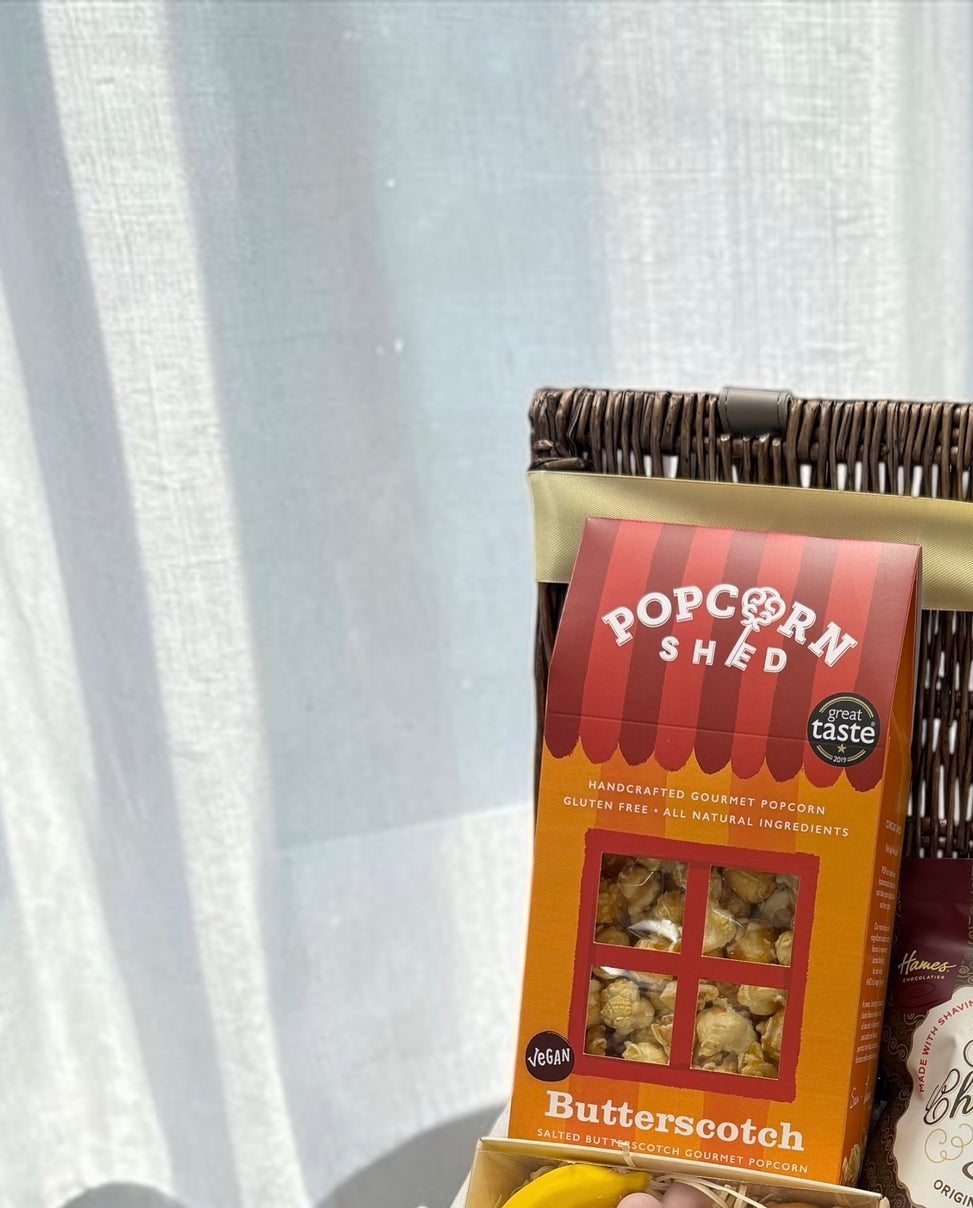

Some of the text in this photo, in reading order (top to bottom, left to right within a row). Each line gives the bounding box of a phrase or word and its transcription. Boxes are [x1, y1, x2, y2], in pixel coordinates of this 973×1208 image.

[601, 584, 858, 667] POPCORN
[659, 636, 787, 673] SHED
[811, 719, 875, 744] taste
[828, 708, 862, 722] great
[833, 755, 848, 763] 2019
[589, 780, 826, 816] HANDCRAFTED GOURMET POPCORN
[563, 797, 849, 837] GLUTEN FREE ALL NATURAL INGREDIENTS
[922, 1027, 939, 1056] WITH
[919, 1067, 927, 1092] MADE
[544, 1090, 804, 1151] Butterscotch
[537, 1128, 808, 1174] SALTED BUTTERSCOTCH GOURMET POPCORN
